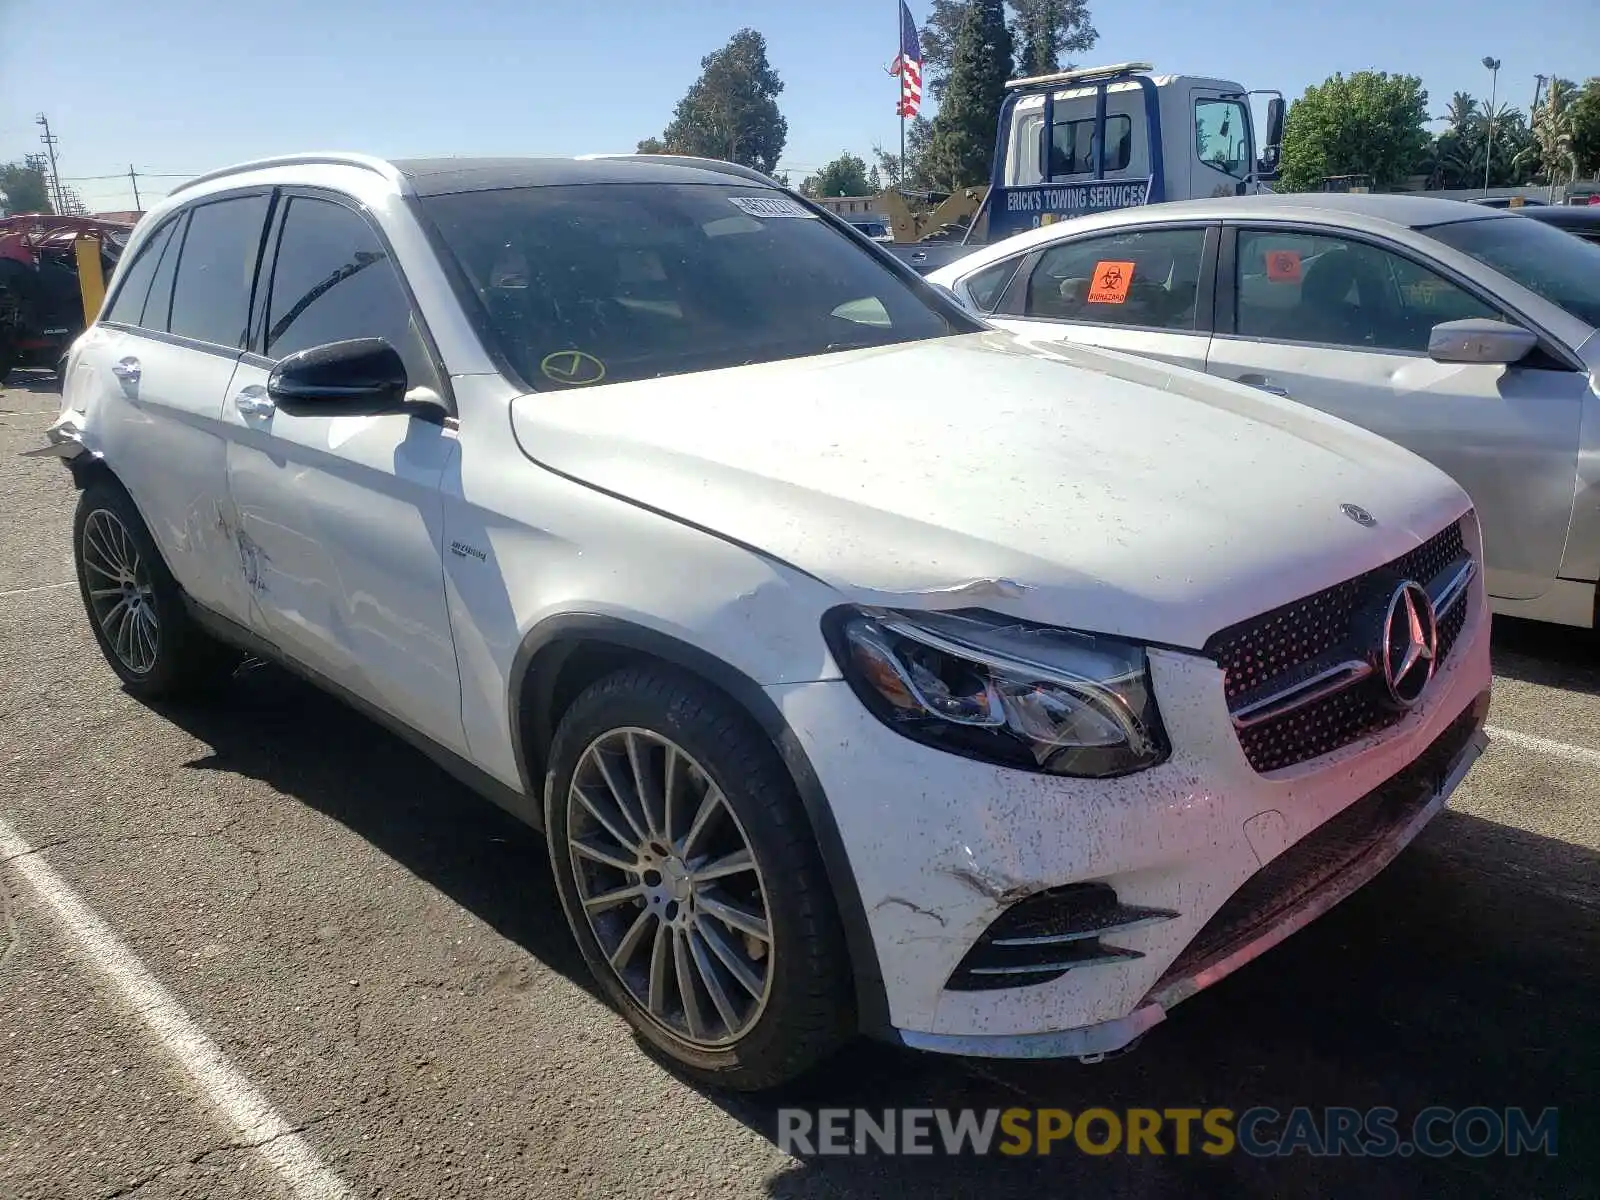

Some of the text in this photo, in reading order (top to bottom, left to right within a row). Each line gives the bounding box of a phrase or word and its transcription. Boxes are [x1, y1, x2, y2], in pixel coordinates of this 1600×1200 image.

[1007, 184, 1145, 211] ERICK'S TOWING SERVICES
[1089, 292, 1125, 301] BIOHAZARD
